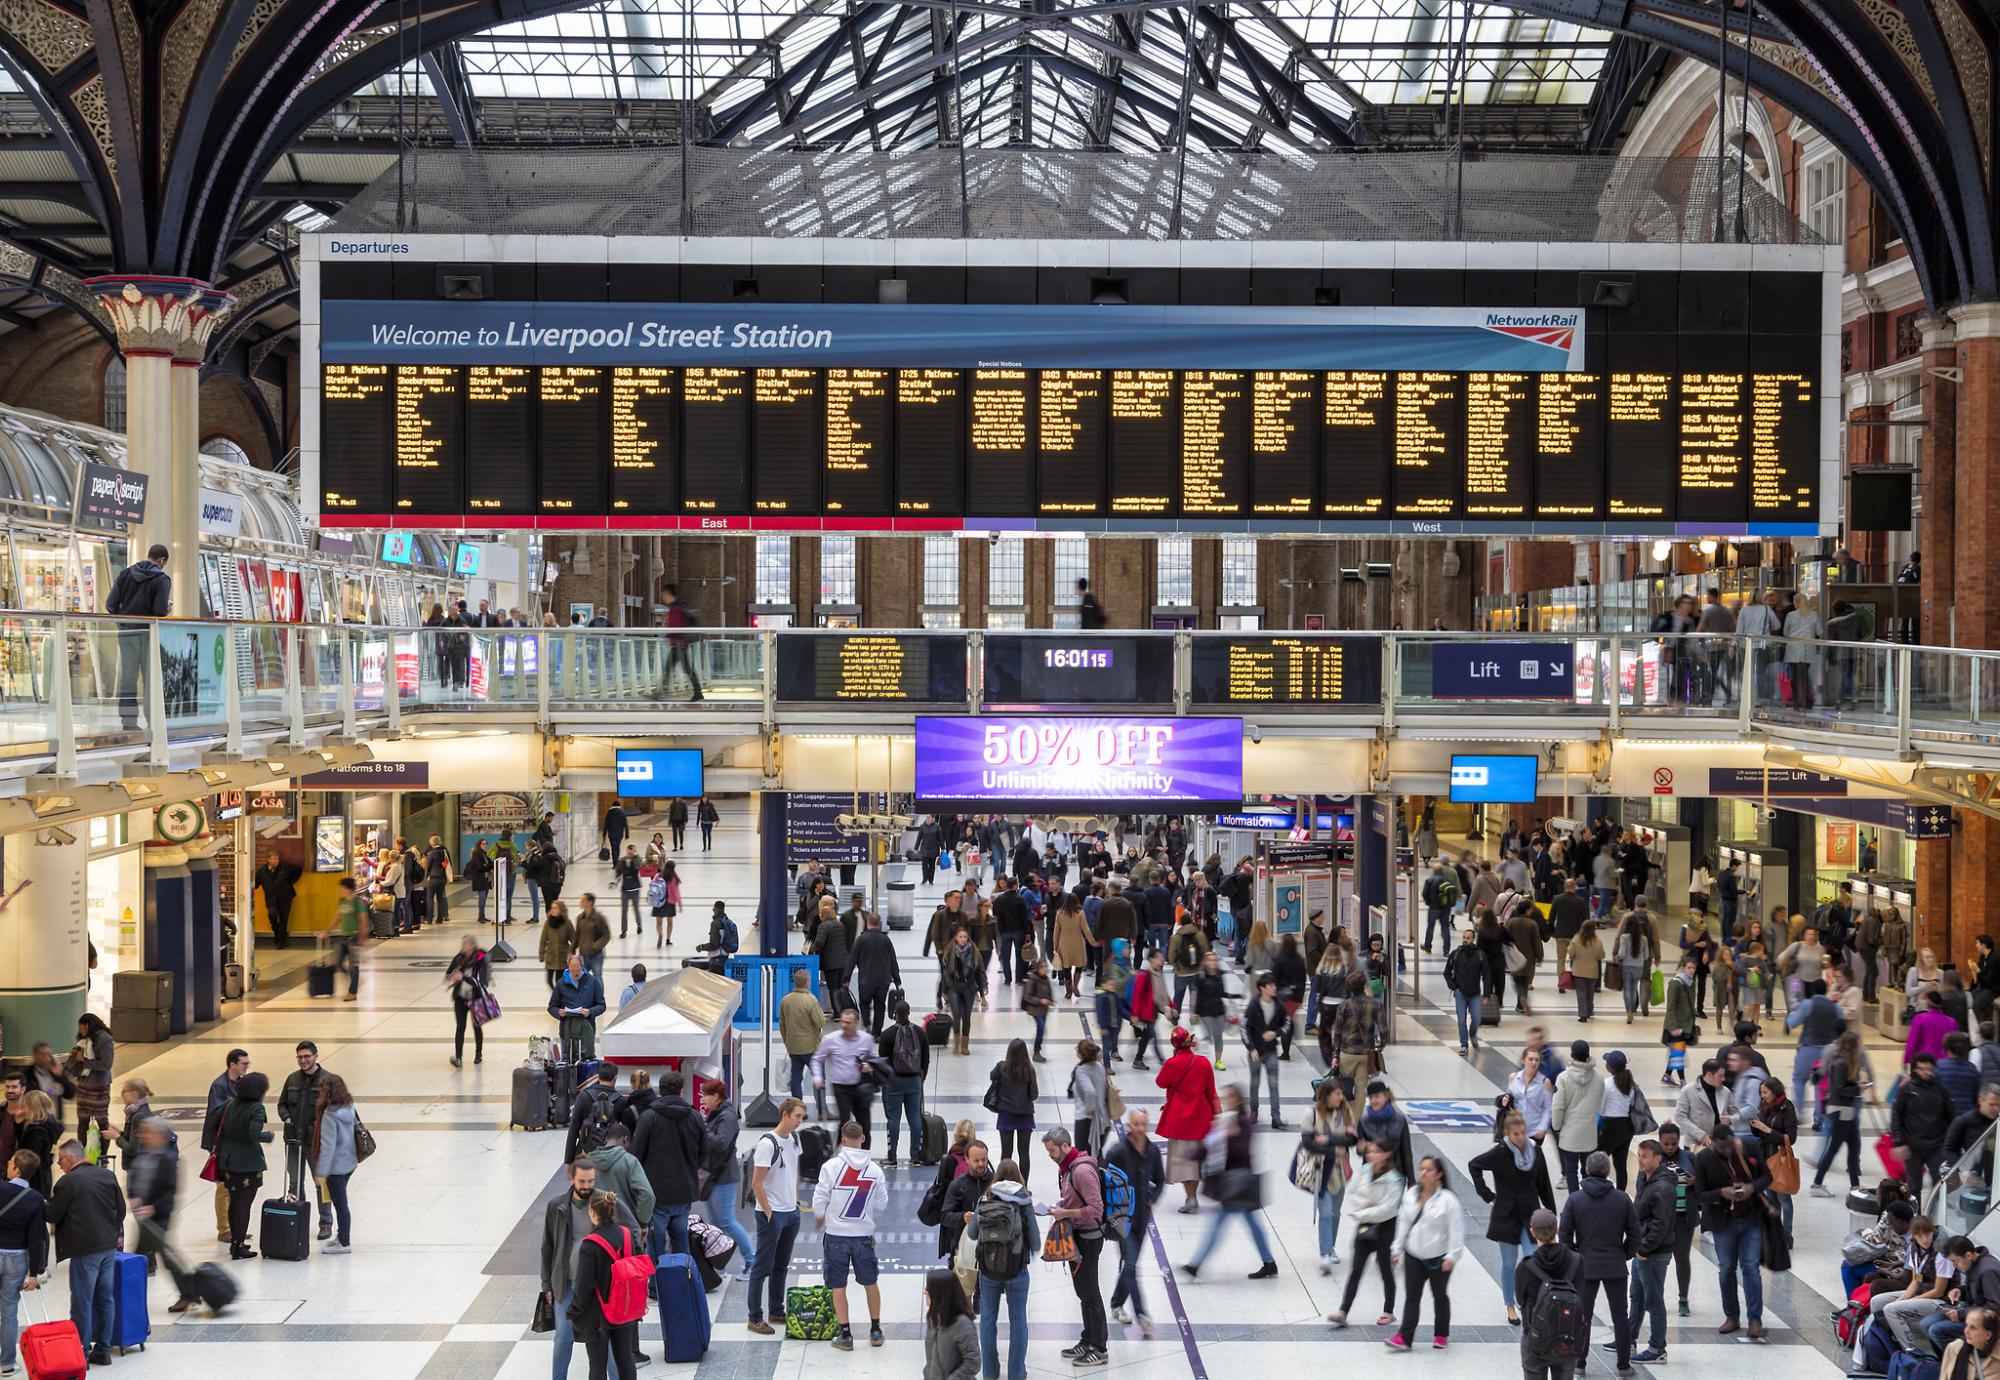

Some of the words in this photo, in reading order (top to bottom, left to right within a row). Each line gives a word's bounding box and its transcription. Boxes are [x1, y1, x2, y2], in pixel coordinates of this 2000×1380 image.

[331, 241, 409, 255] Departures
[1486, 314, 1578, 326] NetworkRail
[371, 324, 471, 346] Welcome
[478, 328, 499, 346] to
[505, 322, 633, 354] Liverpool
[638, 322, 724, 348] Street
[730, 322, 832, 348] Station
[352, 366, 379, 374] Platform
[423, 367, 451, 375] Platform
[495, 367, 523, 375] Platform
[567, 368, 595, 376] Platform
[639, 368, 667, 376] Platform
[711, 368, 739, 377] Platform
[782, 369, 810, 377] Platform
[853, 369, 881, 378] Platform
[925, 370, 953, 378] Platform
[977, 370, 999, 379] Special
[1001, 370, 1025, 379] Notices
[1067, 371, 1095, 379] Platform
[1139, 371, 1167, 379] Platform
[1210, 372, 1237, 380] Platform
[1280, 372, 1308, 380] Platform
[1352, 372, 1380, 381] Platform
[1422, 373, 1450, 381] Platform
[1494, 373, 1522, 381] Platform
[1565, 373, 1593, 382] Platform
[1636, 374, 1664, 382] Platform
[1708, 374, 1736, 382] Platform
[1708, 414, 1735, 423] Platform
[1707, 454, 1735, 463] Platform
[702, 518, 727, 528] East
[1412, 522, 1441, 532] West
[1045, 650, 1088, 667] 16:01
[1090, 654, 1106, 667] 15
[1470, 661, 1500, 677] Lift
[982, 725, 1080, 765] 50%
[1096, 725, 1174, 765] OFF
[375, 764, 381, 772] 8
[383, 764, 393, 772] to
[395, 764, 405, 772] 18
[1792, 772, 1807, 780] Lift
[983, 770, 1073, 788] Unlimited
[1107, 770, 1173, 792] Infinity
[252, 798, 284, 808] CASA
[1223, 815, 1272, 826] information
[732, 966, 748, 975] FREE
